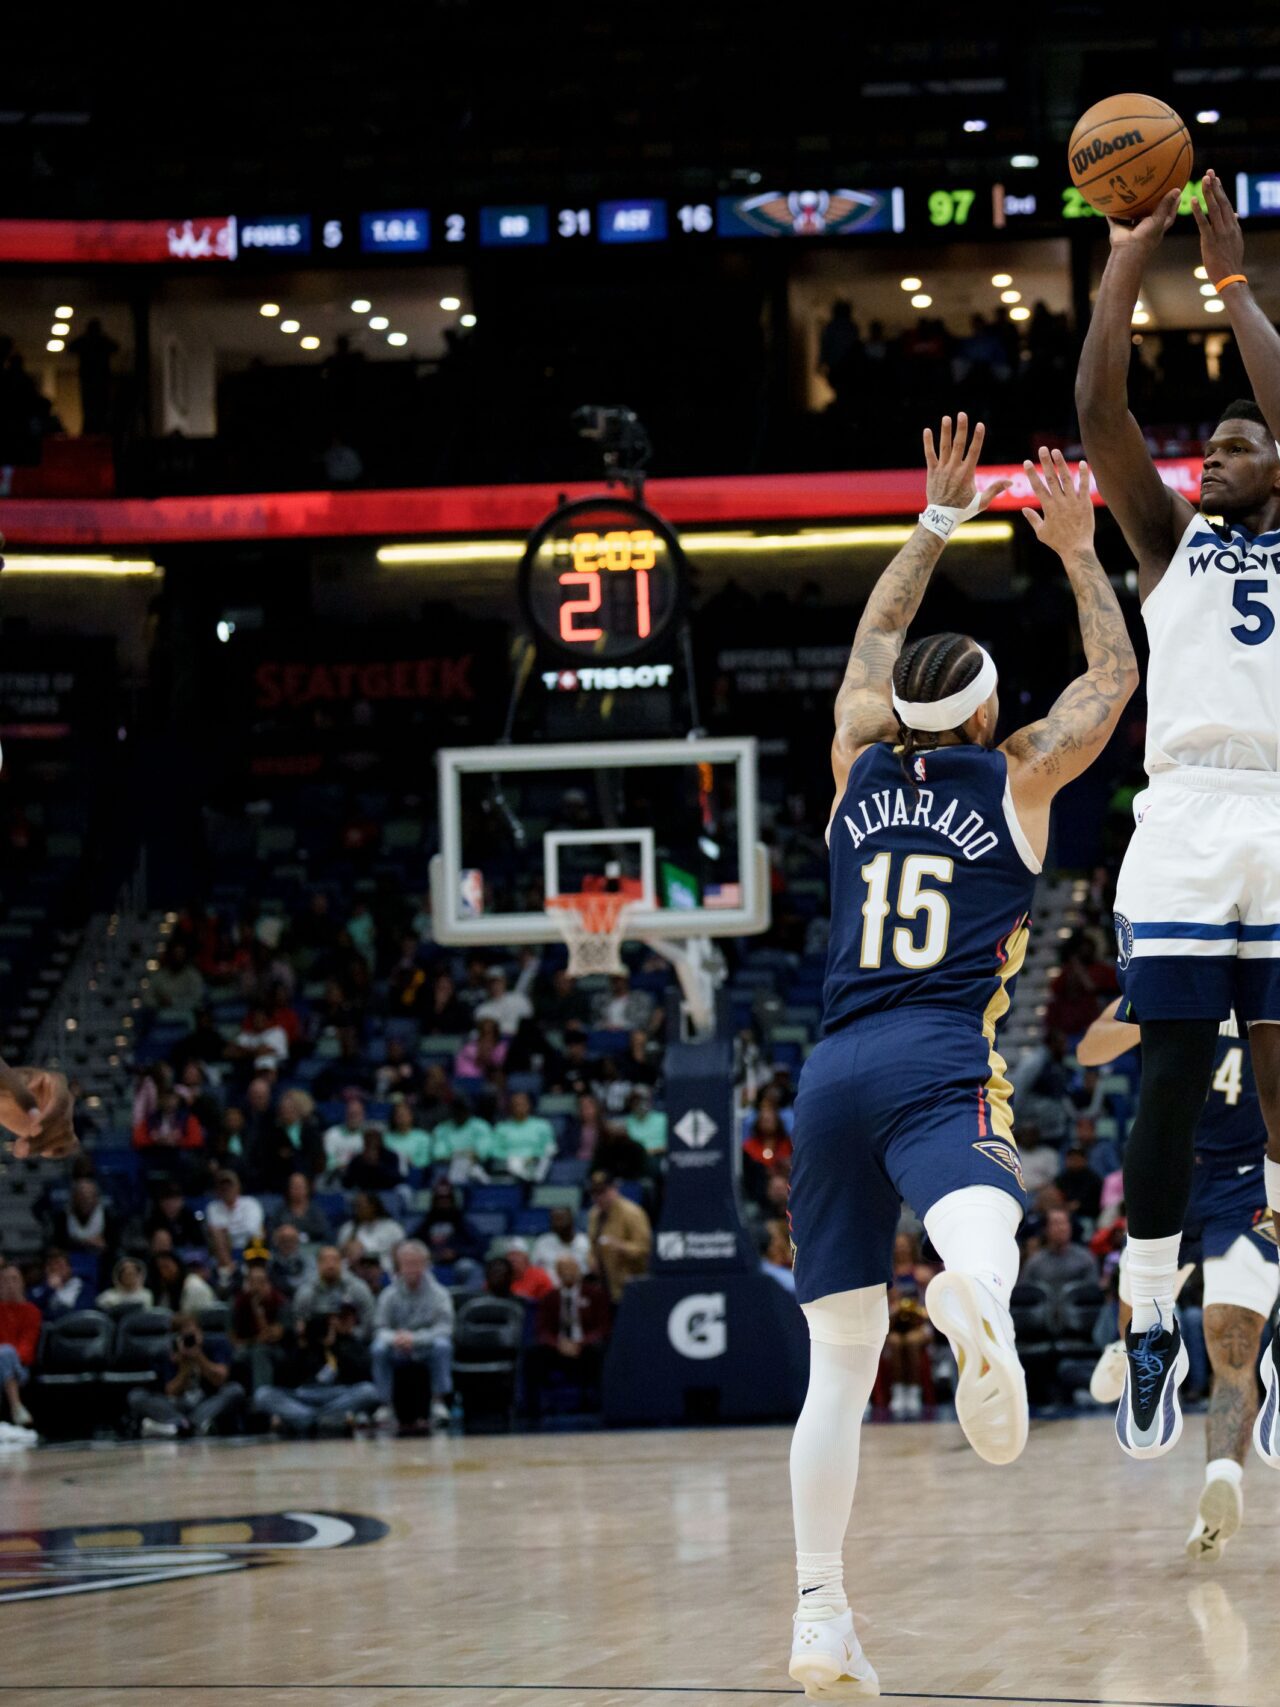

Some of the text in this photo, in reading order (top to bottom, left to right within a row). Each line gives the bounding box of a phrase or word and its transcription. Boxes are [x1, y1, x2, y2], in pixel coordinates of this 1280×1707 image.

[1072, 129, 1144, 175] Wilson
[445, 214, 465, 242] 2
[558, 208, 591, 238] 31
[677, 203, 713, 233] 16
[928, 189, 976, 226] 97
[559, 570, 650, 642] 21
[1230, 579, 1276, 646] 5
[844, 788, 999, 861] ALVARADO
[859, 852, 954, 970] 15
[1212, 1048, 1244, 1106] 4
[668, 1293, 727, 1360] G
